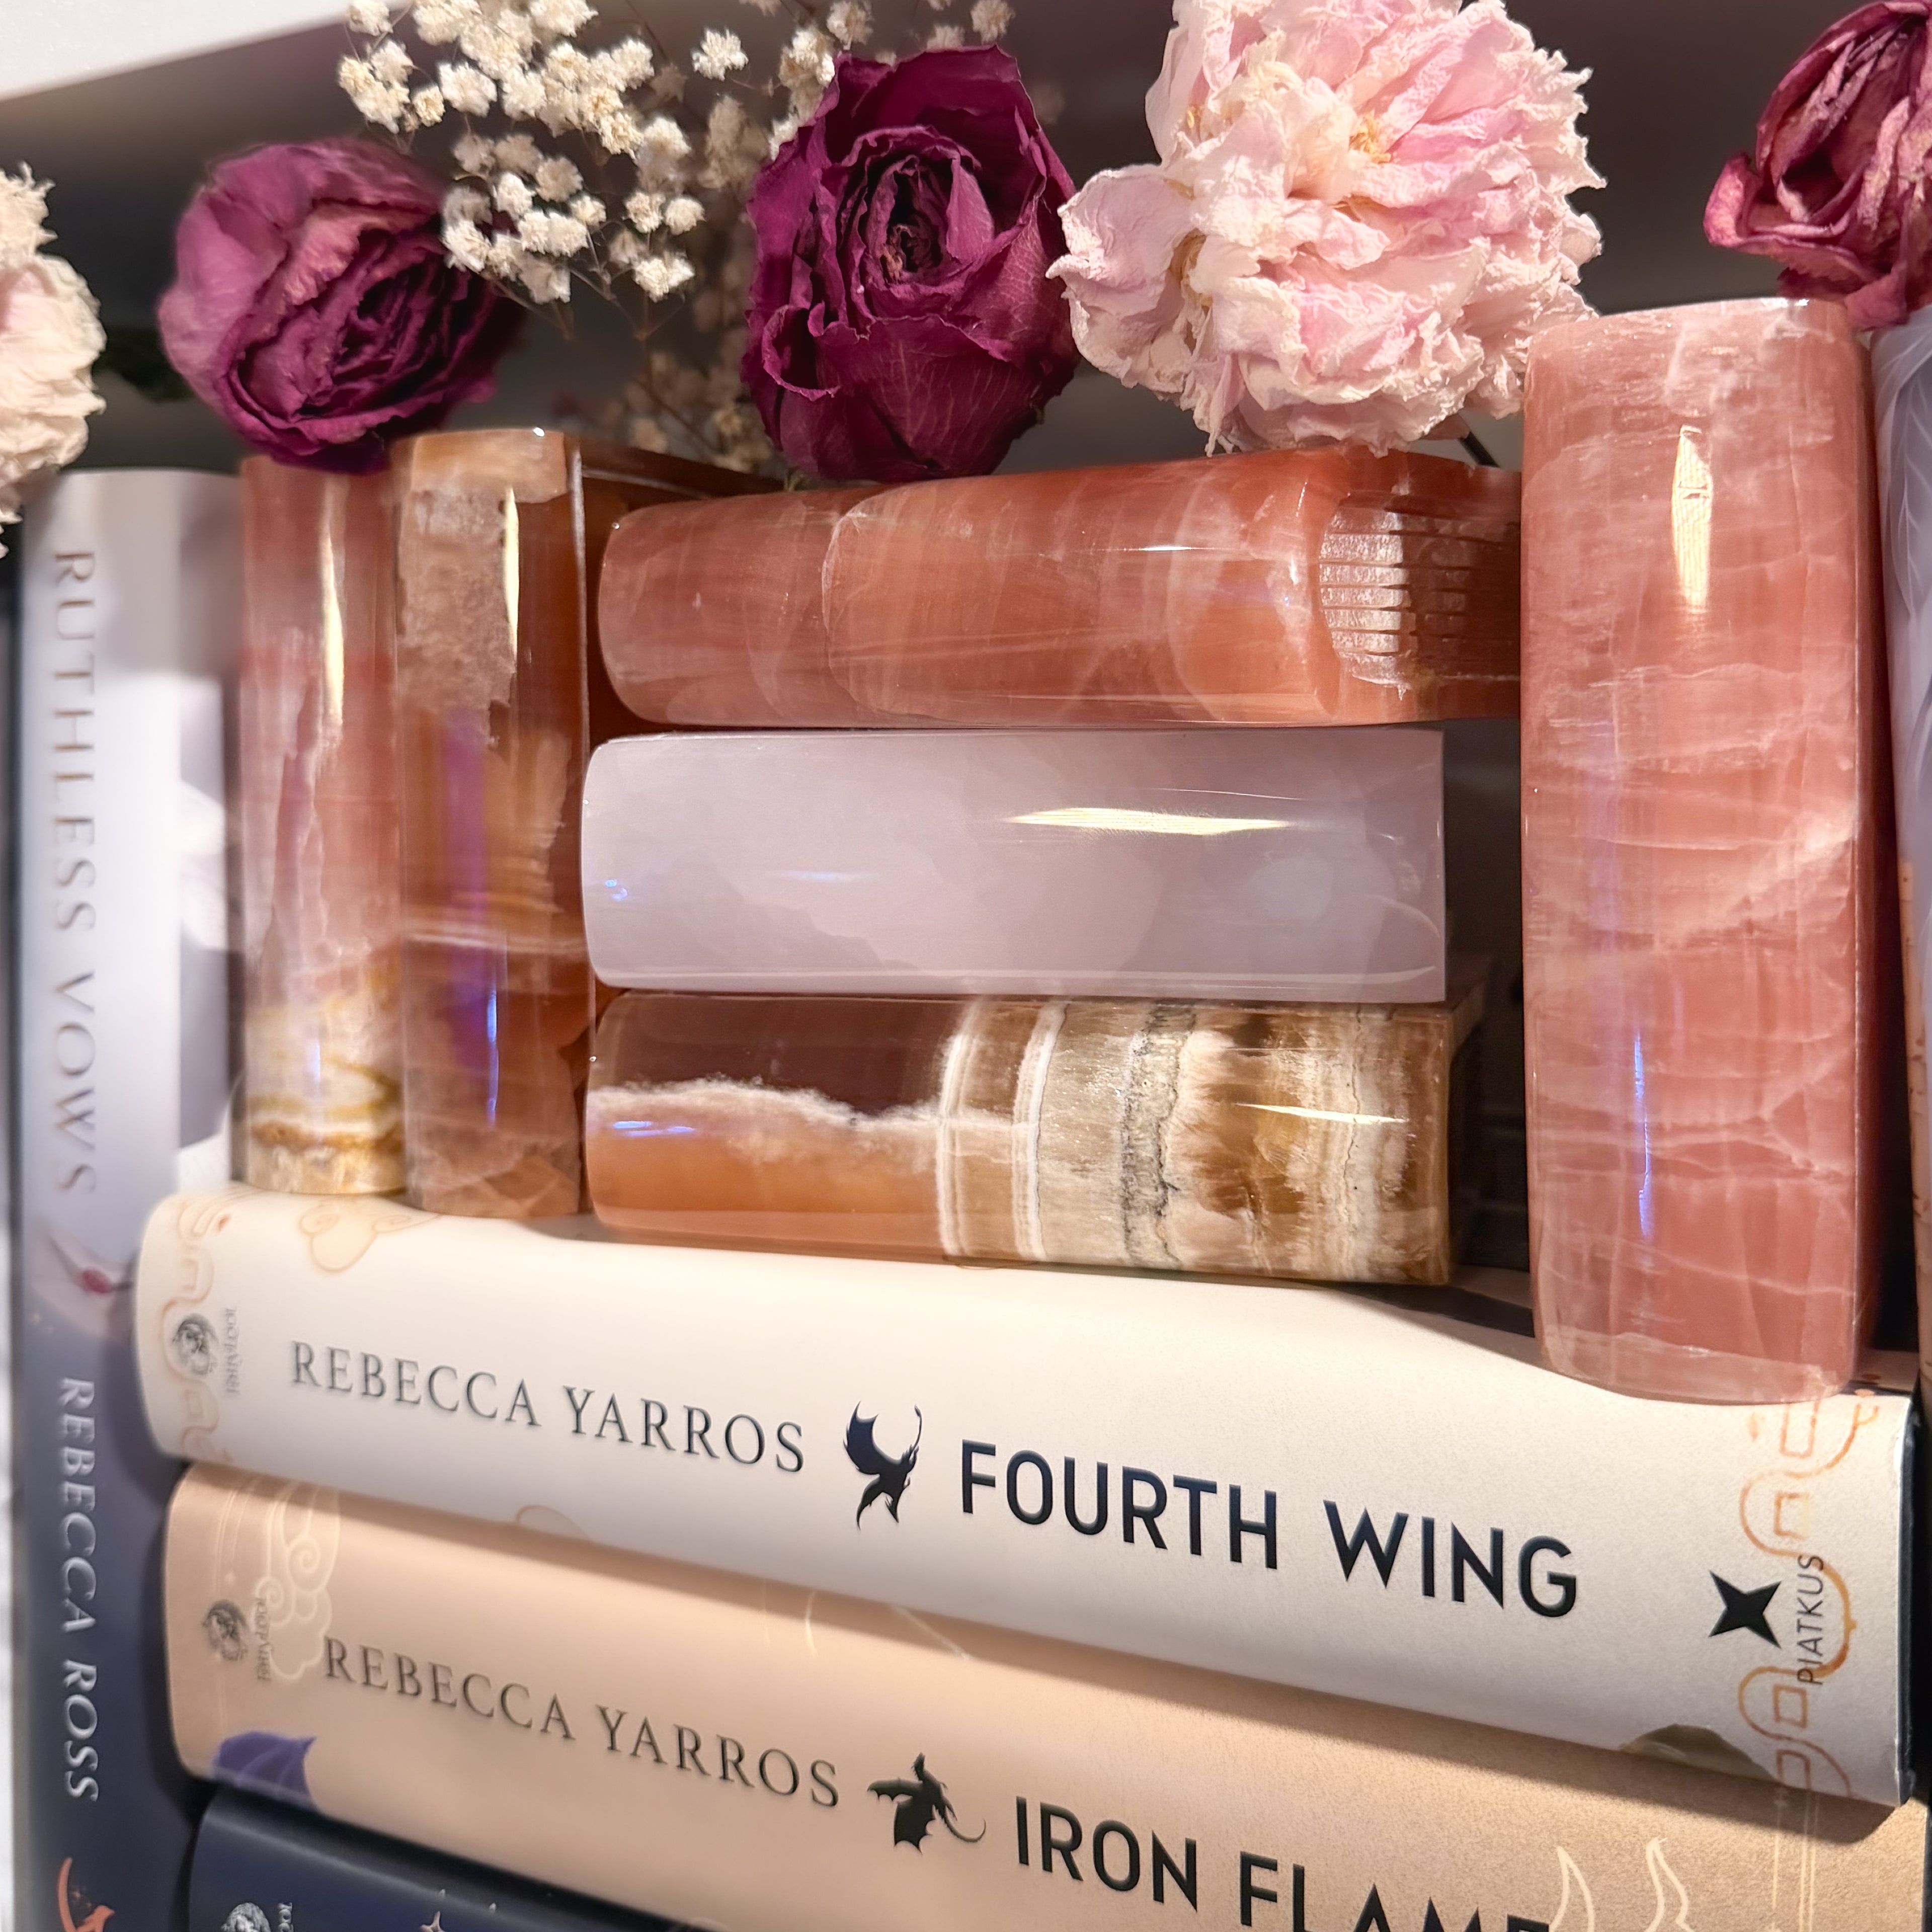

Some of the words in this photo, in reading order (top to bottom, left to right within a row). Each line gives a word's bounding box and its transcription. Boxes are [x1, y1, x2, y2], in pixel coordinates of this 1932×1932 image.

[53, 551, 96, 933] RUTHLESS
[54, 972, 97, 1195] VOWS
[290, 1340, 541, 1427] REBECCA
[563, 1385, 804, 1473] YARROS
[58, 1378, 97, 1633] REBECCA
[961, 1438, 1279, 1571] FOURTH
[1322, 1497, 1578, 1619] WING
[1797, 1555, 1824, 1685] PIATKUS
[63, 1659, 99, 1802] ROSS
[324, 1636, 576, 1740] REBECCA
[595, 1704, 839, 1808] YARROS
[1015, 1794, 1197, 1912] IRON
